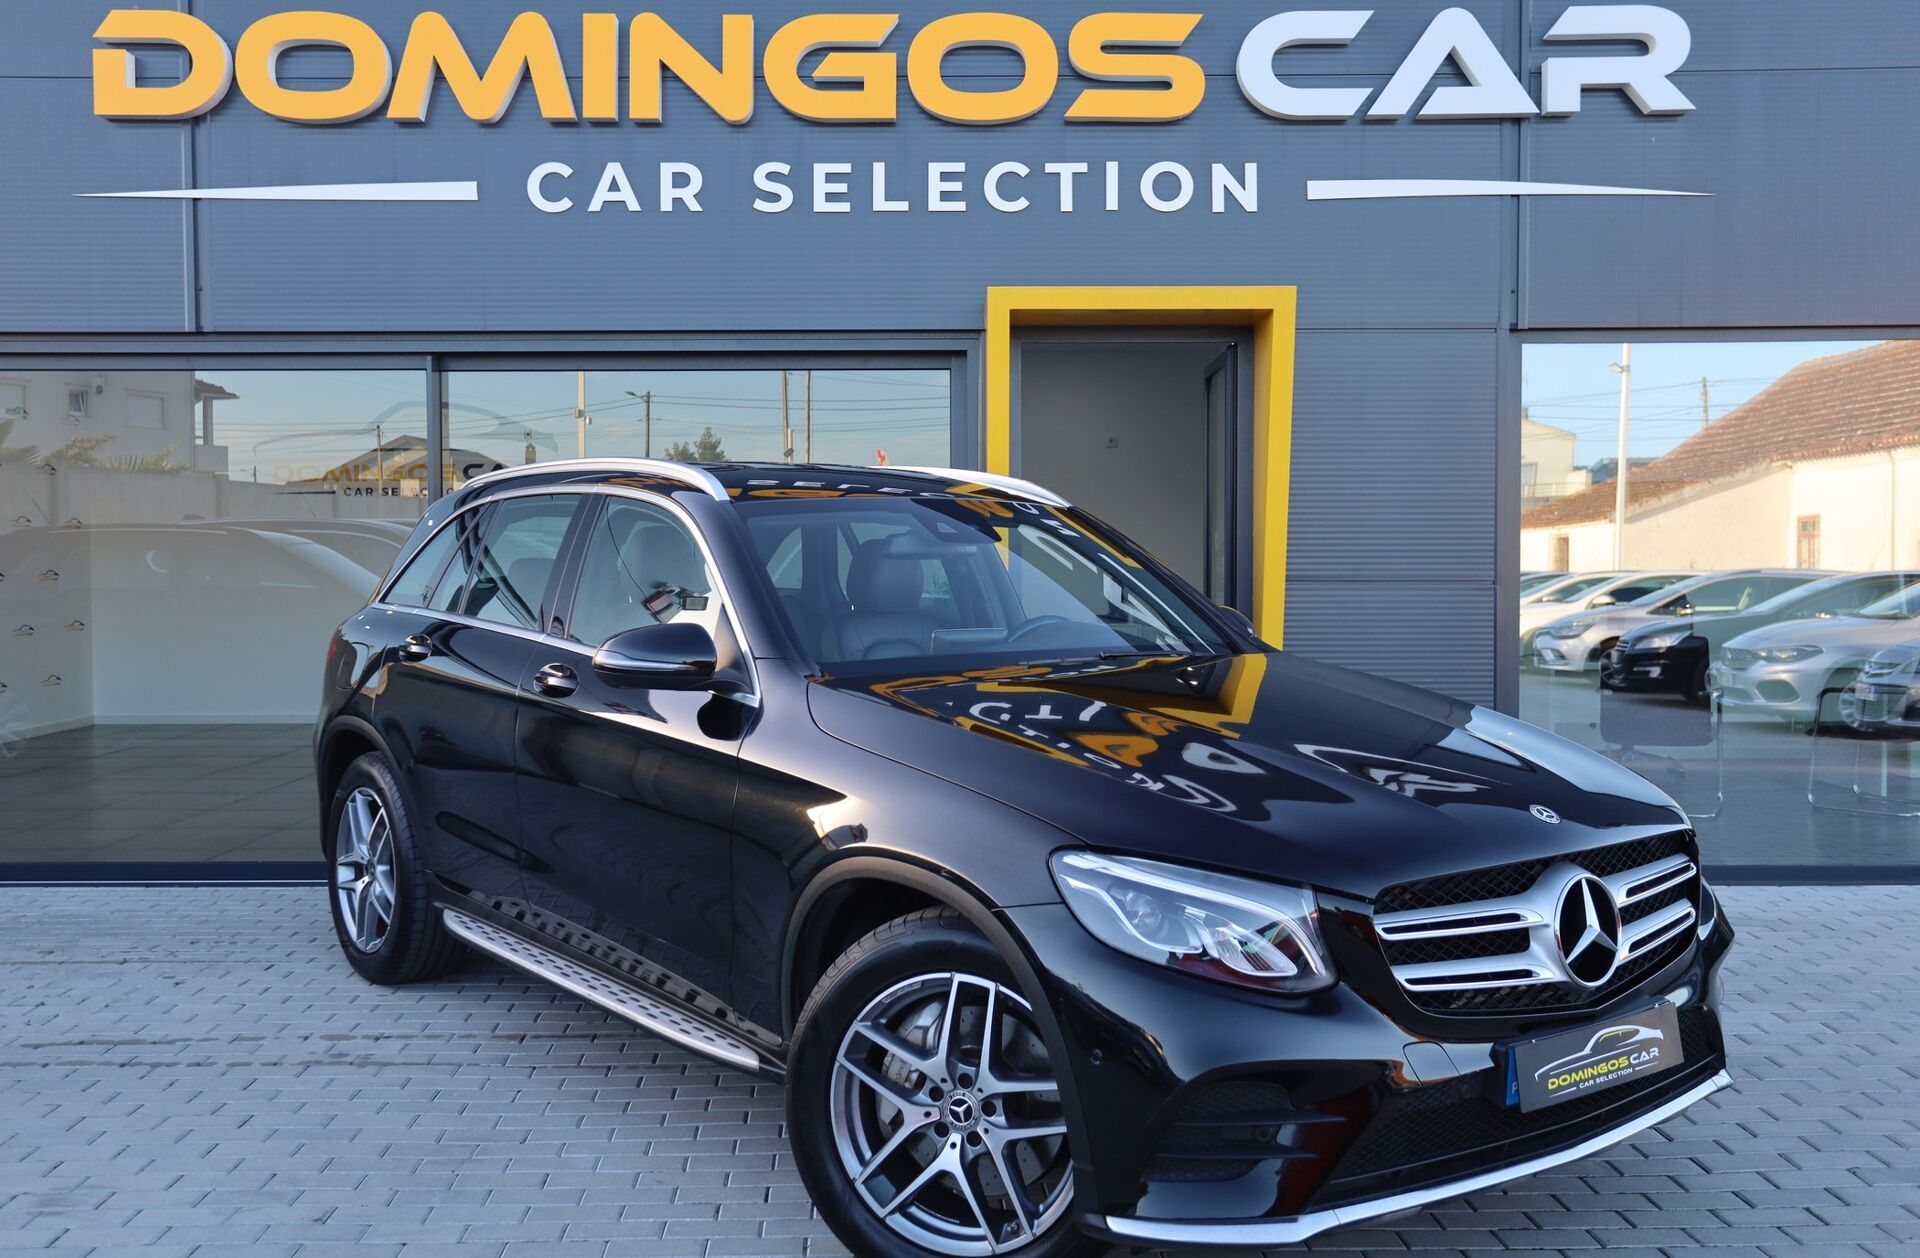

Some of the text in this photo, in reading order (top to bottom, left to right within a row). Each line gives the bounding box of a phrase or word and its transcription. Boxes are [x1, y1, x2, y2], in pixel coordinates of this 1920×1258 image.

[93, 5, 1697, 124] DOMINGOS CAR
[526, 161, 1259, 213] CAR SELECTION
[343, 487, 373, 497] CAR
[1547, 1047, 1660, 1090] DOMINGOS CAR
[1579, 1067, 1634, 1089] CAR SELECTION
